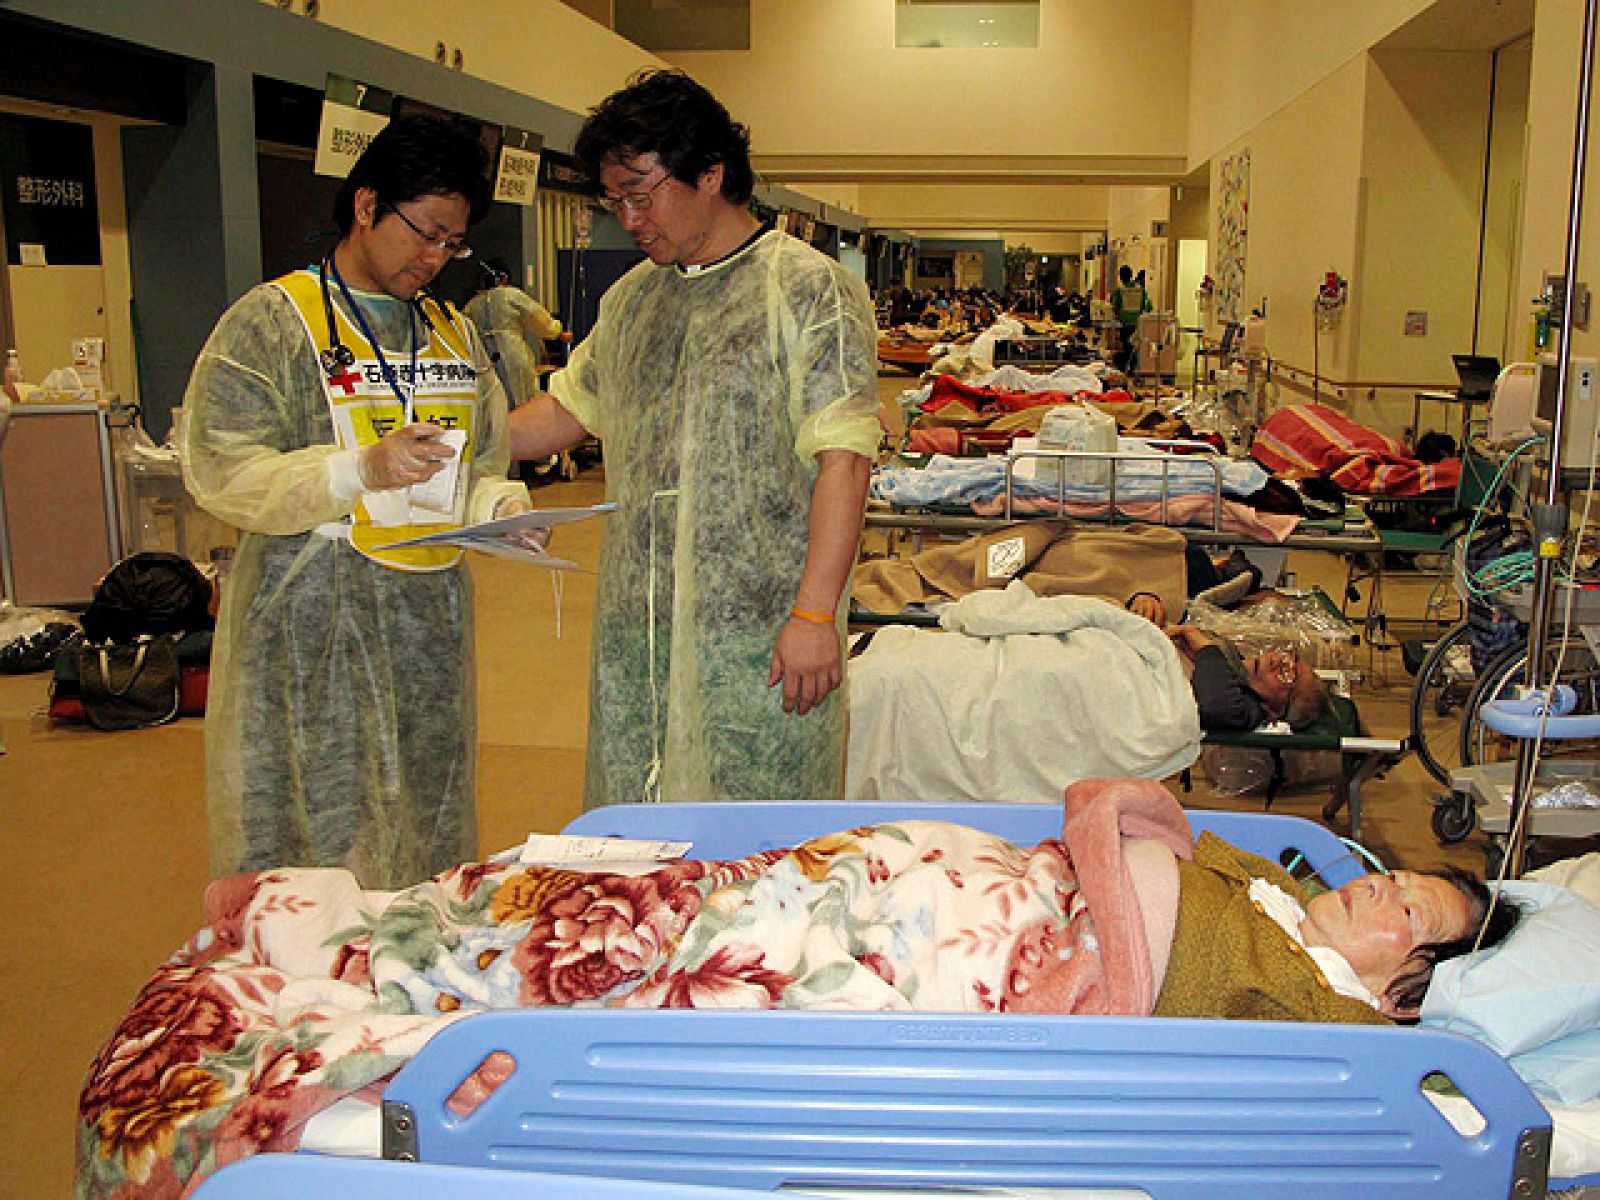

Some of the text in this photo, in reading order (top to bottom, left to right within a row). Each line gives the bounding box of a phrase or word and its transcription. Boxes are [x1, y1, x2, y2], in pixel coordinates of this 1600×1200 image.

[356, 84, 367, 106] 7
[17, 176, 84, 208] 整形外科
